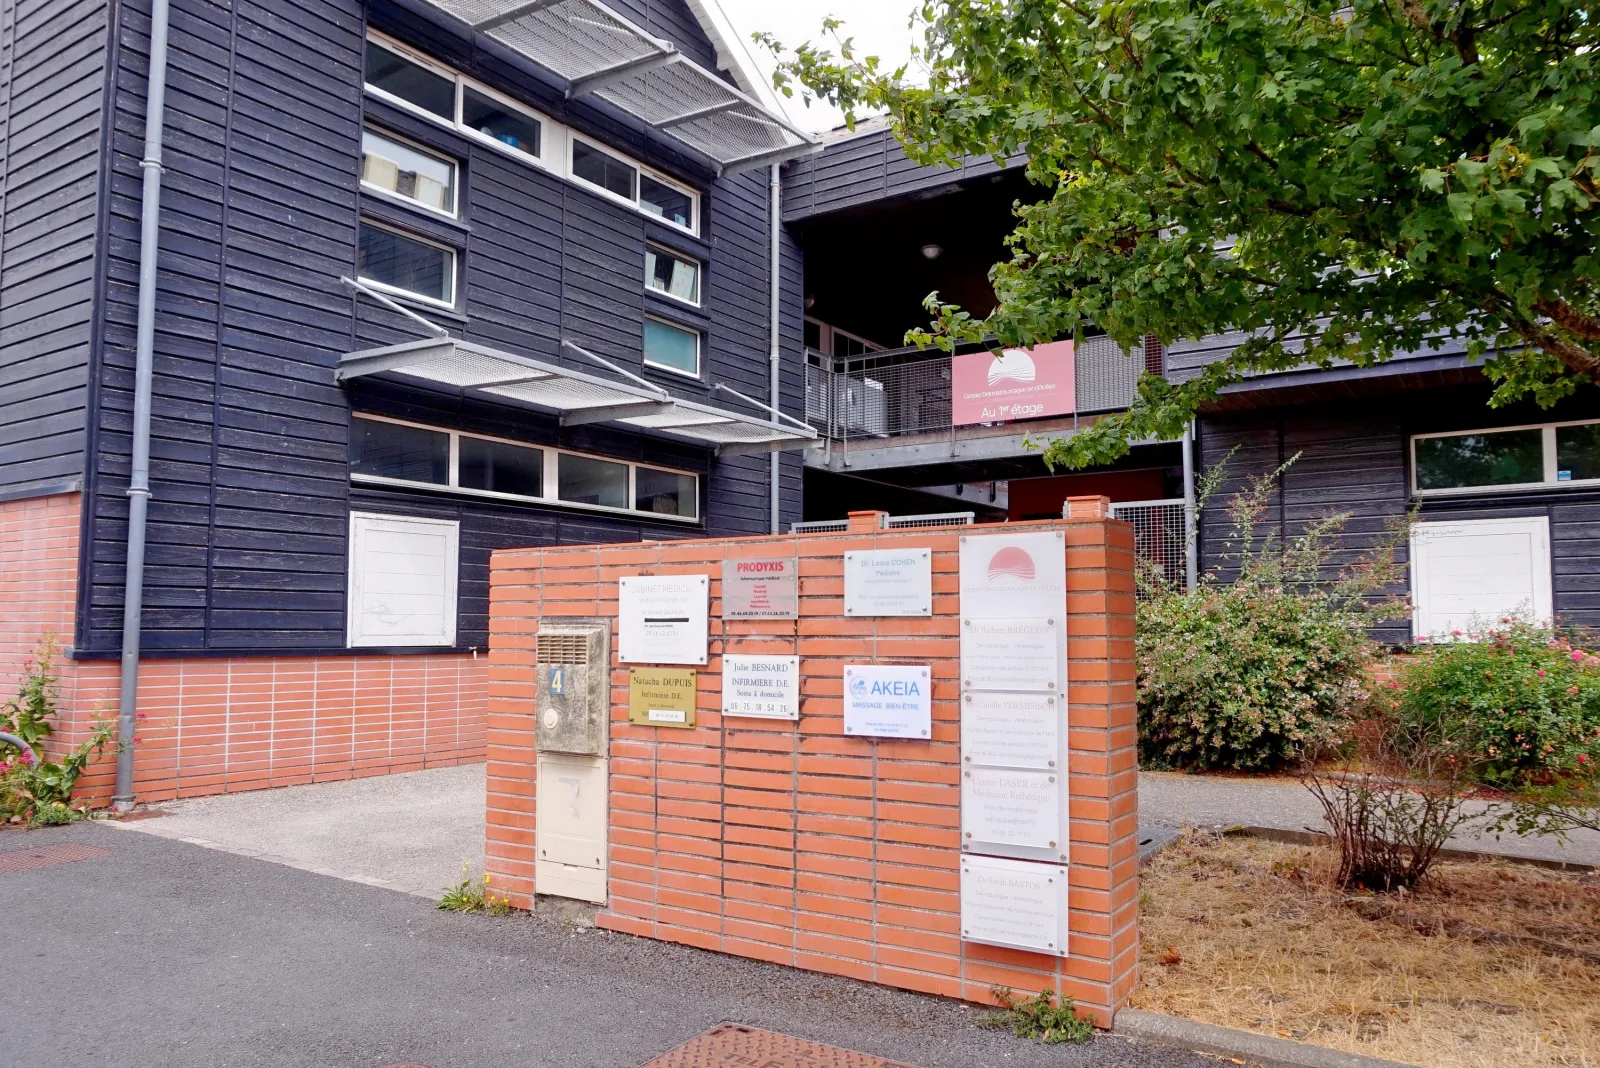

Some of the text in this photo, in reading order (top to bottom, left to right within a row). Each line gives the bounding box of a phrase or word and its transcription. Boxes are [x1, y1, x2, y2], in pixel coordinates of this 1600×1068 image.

[981, 404, 1043, 418] Au 1er étage
[737, 562, 784, 572] PRODYXIS
[631, 584, 662, 594] CABINET
[734, 663, 788, 672] Julie BESNARD
[552, 670, 562, 692] 4
[633, 677, 692, 687] Natacha DUPUIS
[732, 678, 773, 687] INFIRMIERE
[871, 681, 920, 696] AKEIA
[886, 702, 919, 710] BIEN-ÊTRE
[976, 700, 1001, 708] Camille
[972, 777, 996, 787] Centre
[999, 778, 1029, 788] LASER
[1039, 781, 1049, 790] de
[972, 788, 1050, 803] Médecine Esthétique
[978, 876, 1041, 890] Dr Sarah BASTOS
